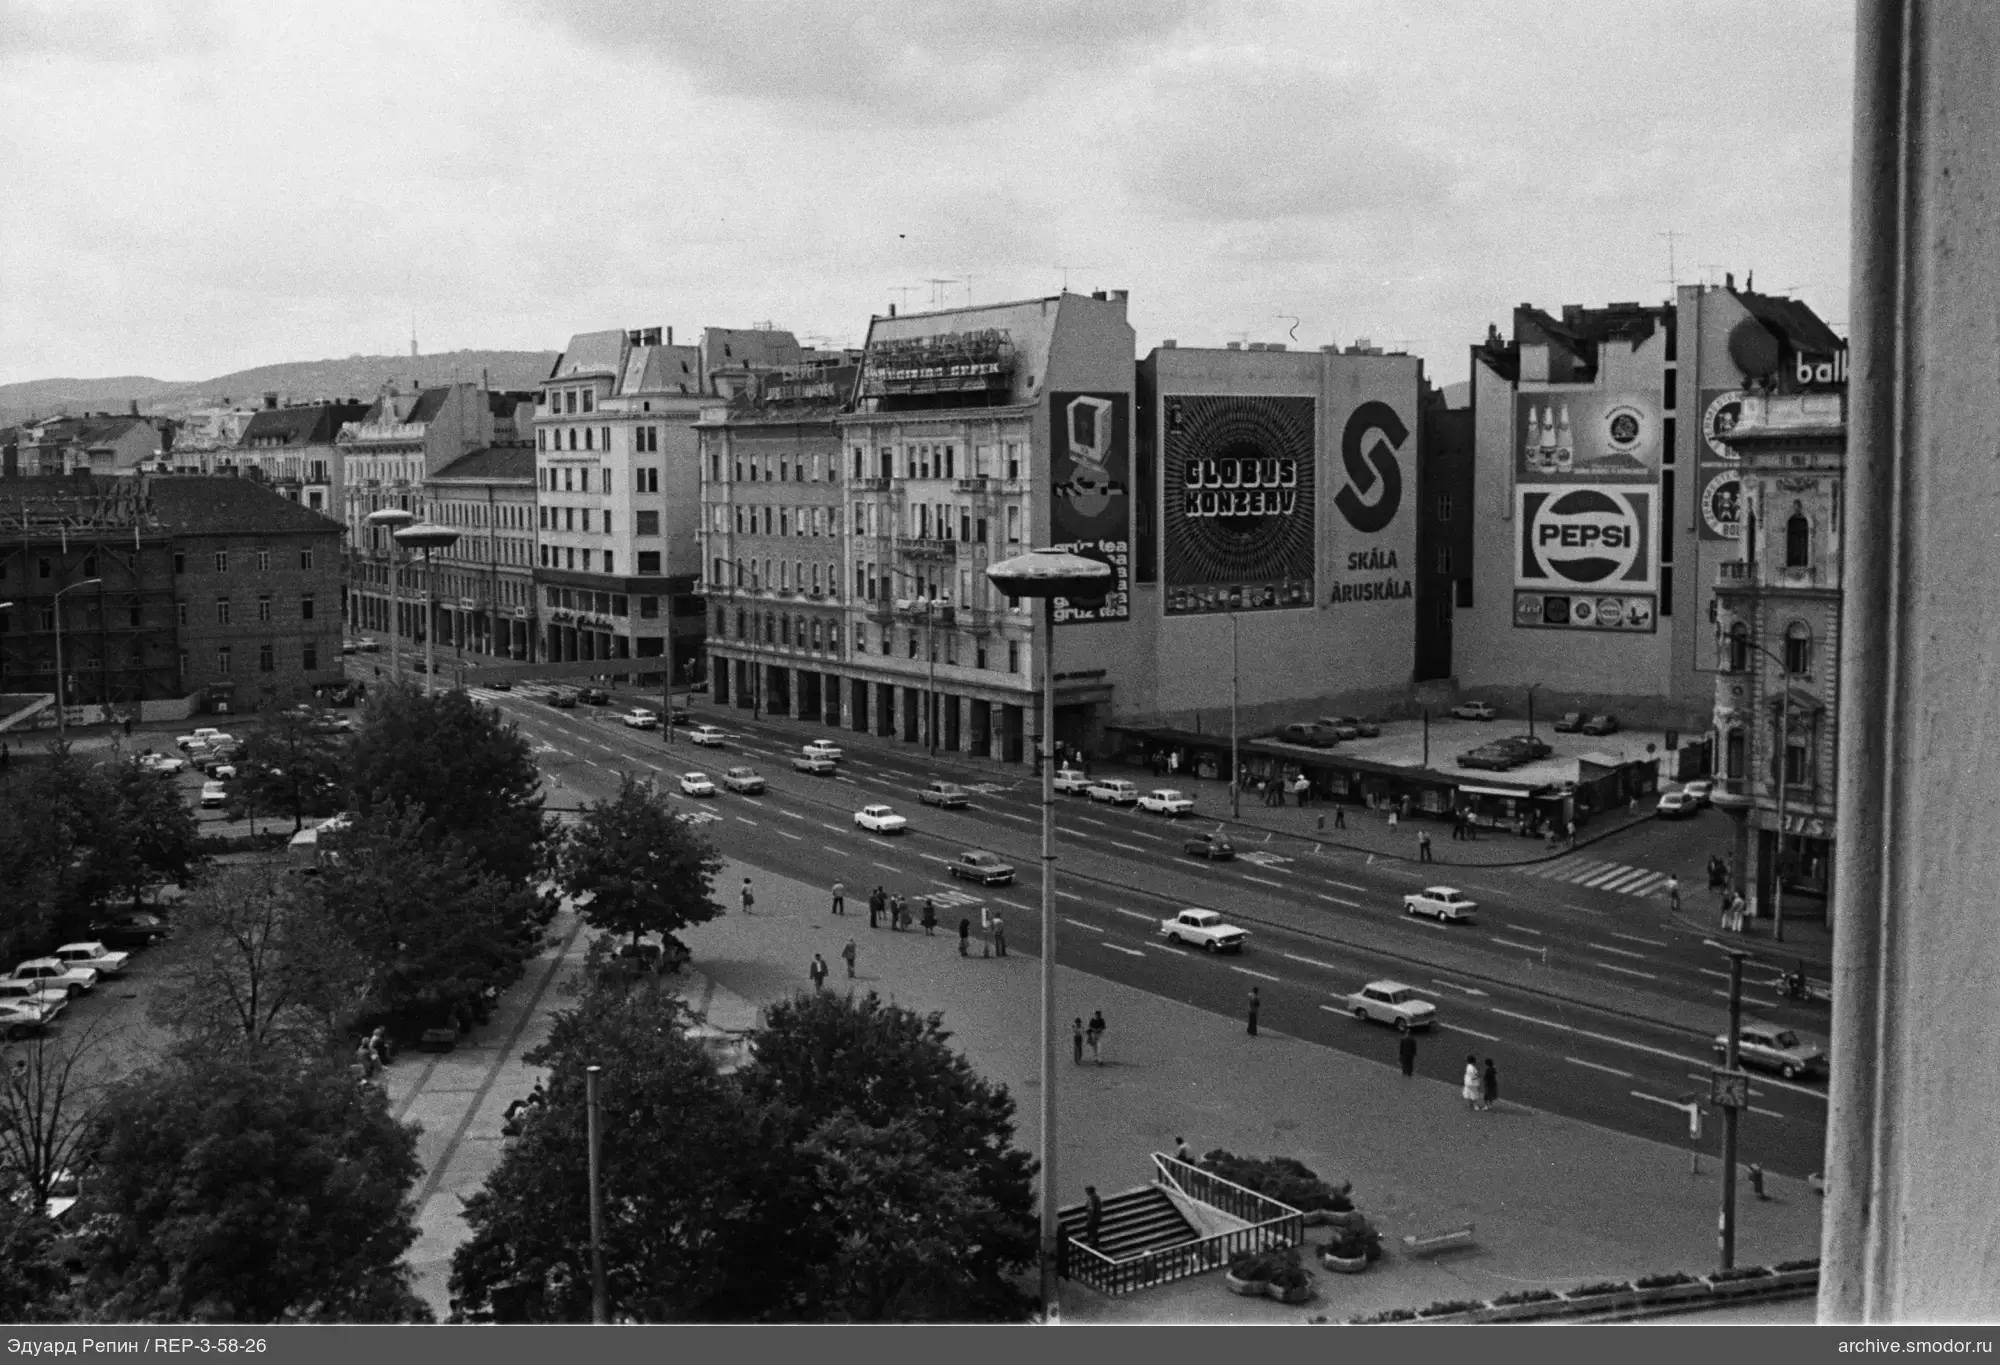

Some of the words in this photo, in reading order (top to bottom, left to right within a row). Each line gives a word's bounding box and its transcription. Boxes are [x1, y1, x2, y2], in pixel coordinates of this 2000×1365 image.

[1184, 458, 1298, 489] GLOBUS
[1184, 489, 1297, 517] KONZERV
[1098, 539, 1128, 553] tea
[1540, 524, 1631, 548] PEPSI
[1348, 548, 1397, 571] SKÁLA
